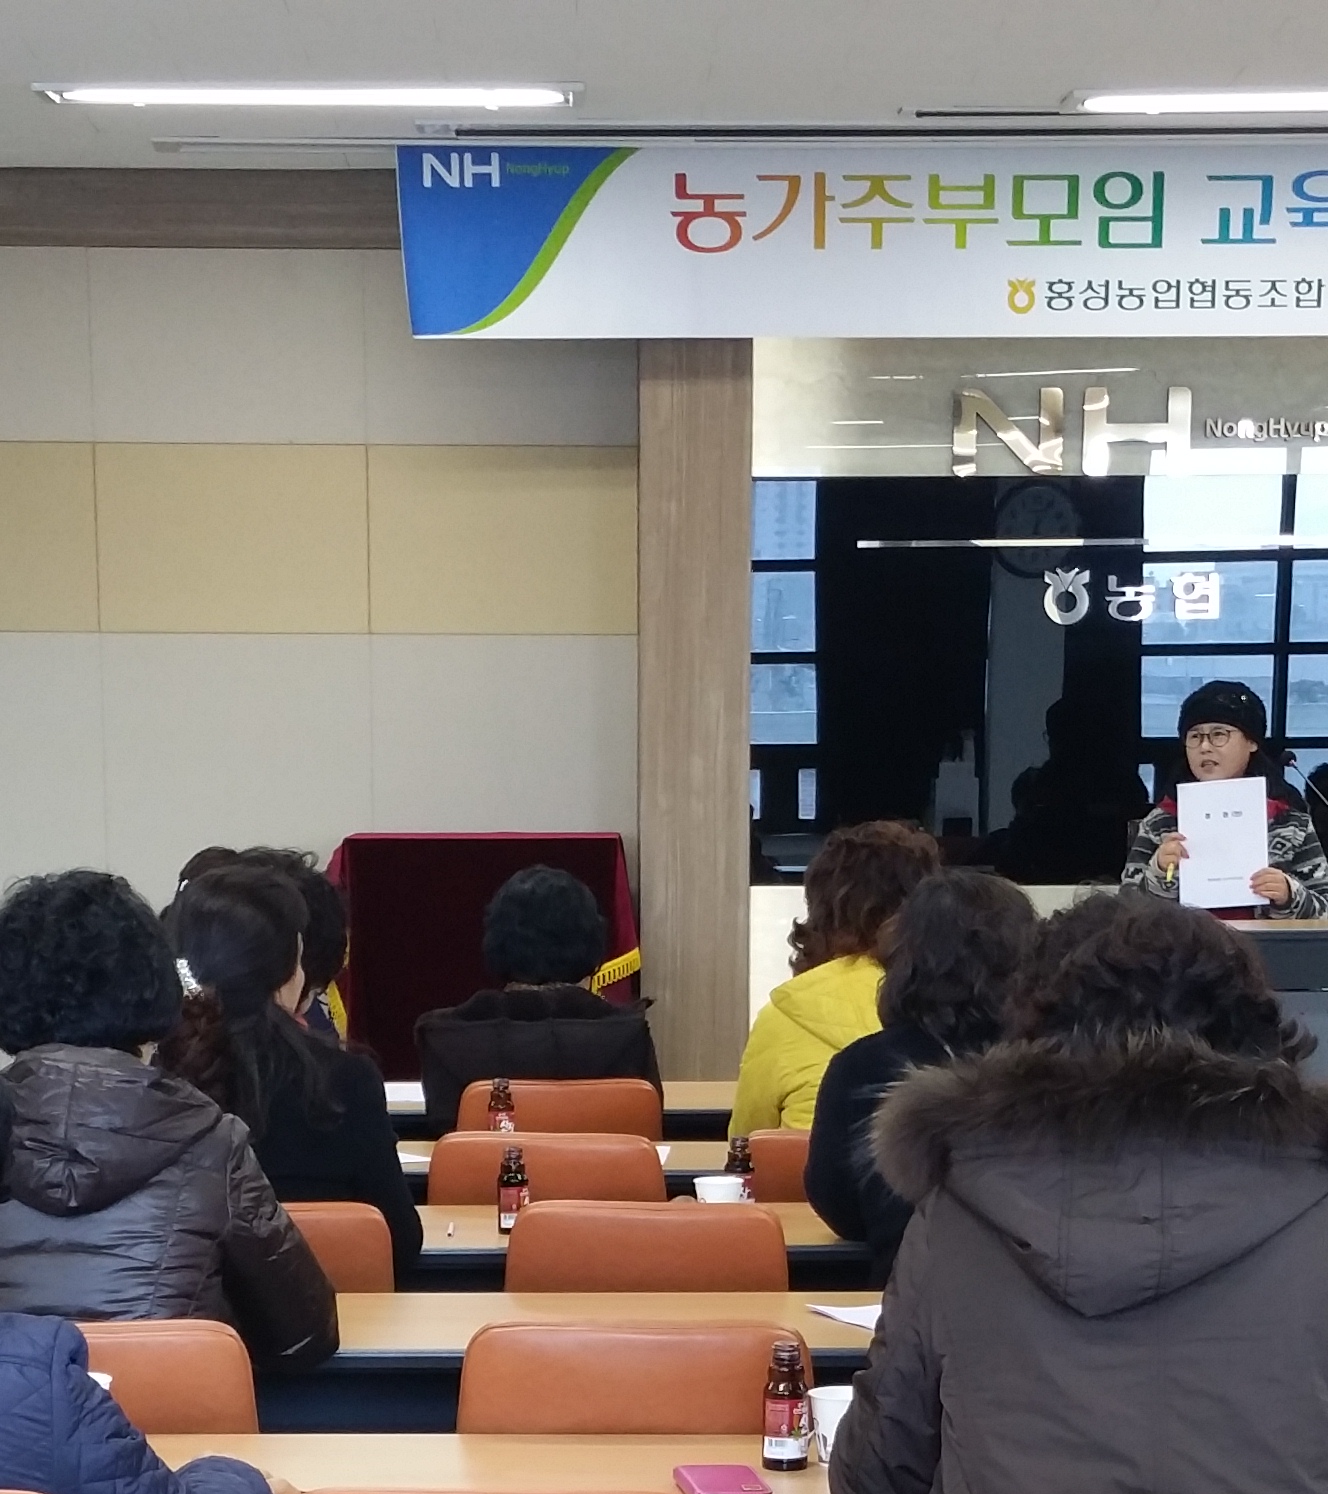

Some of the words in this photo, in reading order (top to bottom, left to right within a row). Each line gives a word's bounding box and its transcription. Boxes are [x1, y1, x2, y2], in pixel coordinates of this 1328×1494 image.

[422, 151, 501, 188] NH
[669, 169, 1166, 254] 농가주부모임
[1044, 278, 1327, 312] 홍성농업협동조합
[951, 385, 1193, 478] NH
[1104, 570, 1221, 623] 농협
